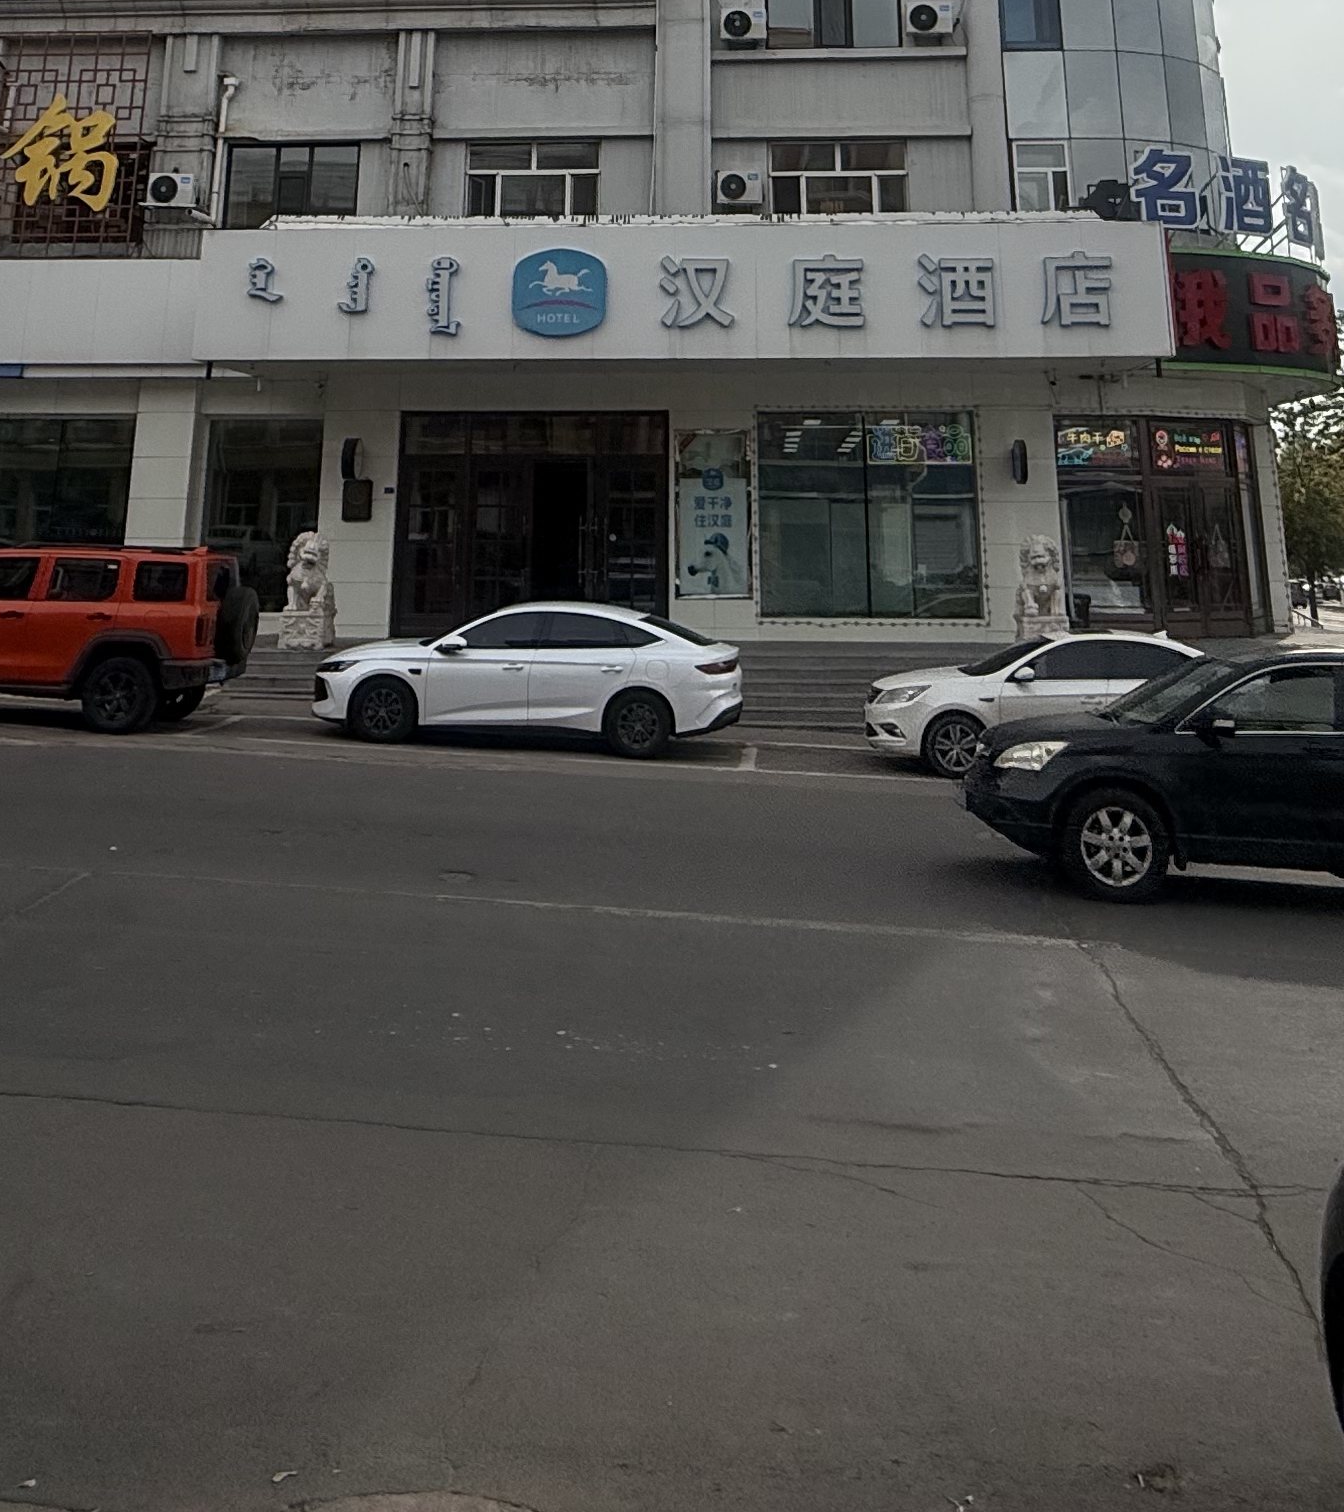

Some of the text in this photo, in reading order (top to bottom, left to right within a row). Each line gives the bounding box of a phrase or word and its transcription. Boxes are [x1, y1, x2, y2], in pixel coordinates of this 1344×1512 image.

[659, 250, 1113, 330] 汉庭酒店
[537, 313, 579, 324] HOTEL
[1066, 431, 1103, 445] 牛肉干
[694, 496, 732, 510] 爱干净
[694, 514, 733, 528] 住汉庭
